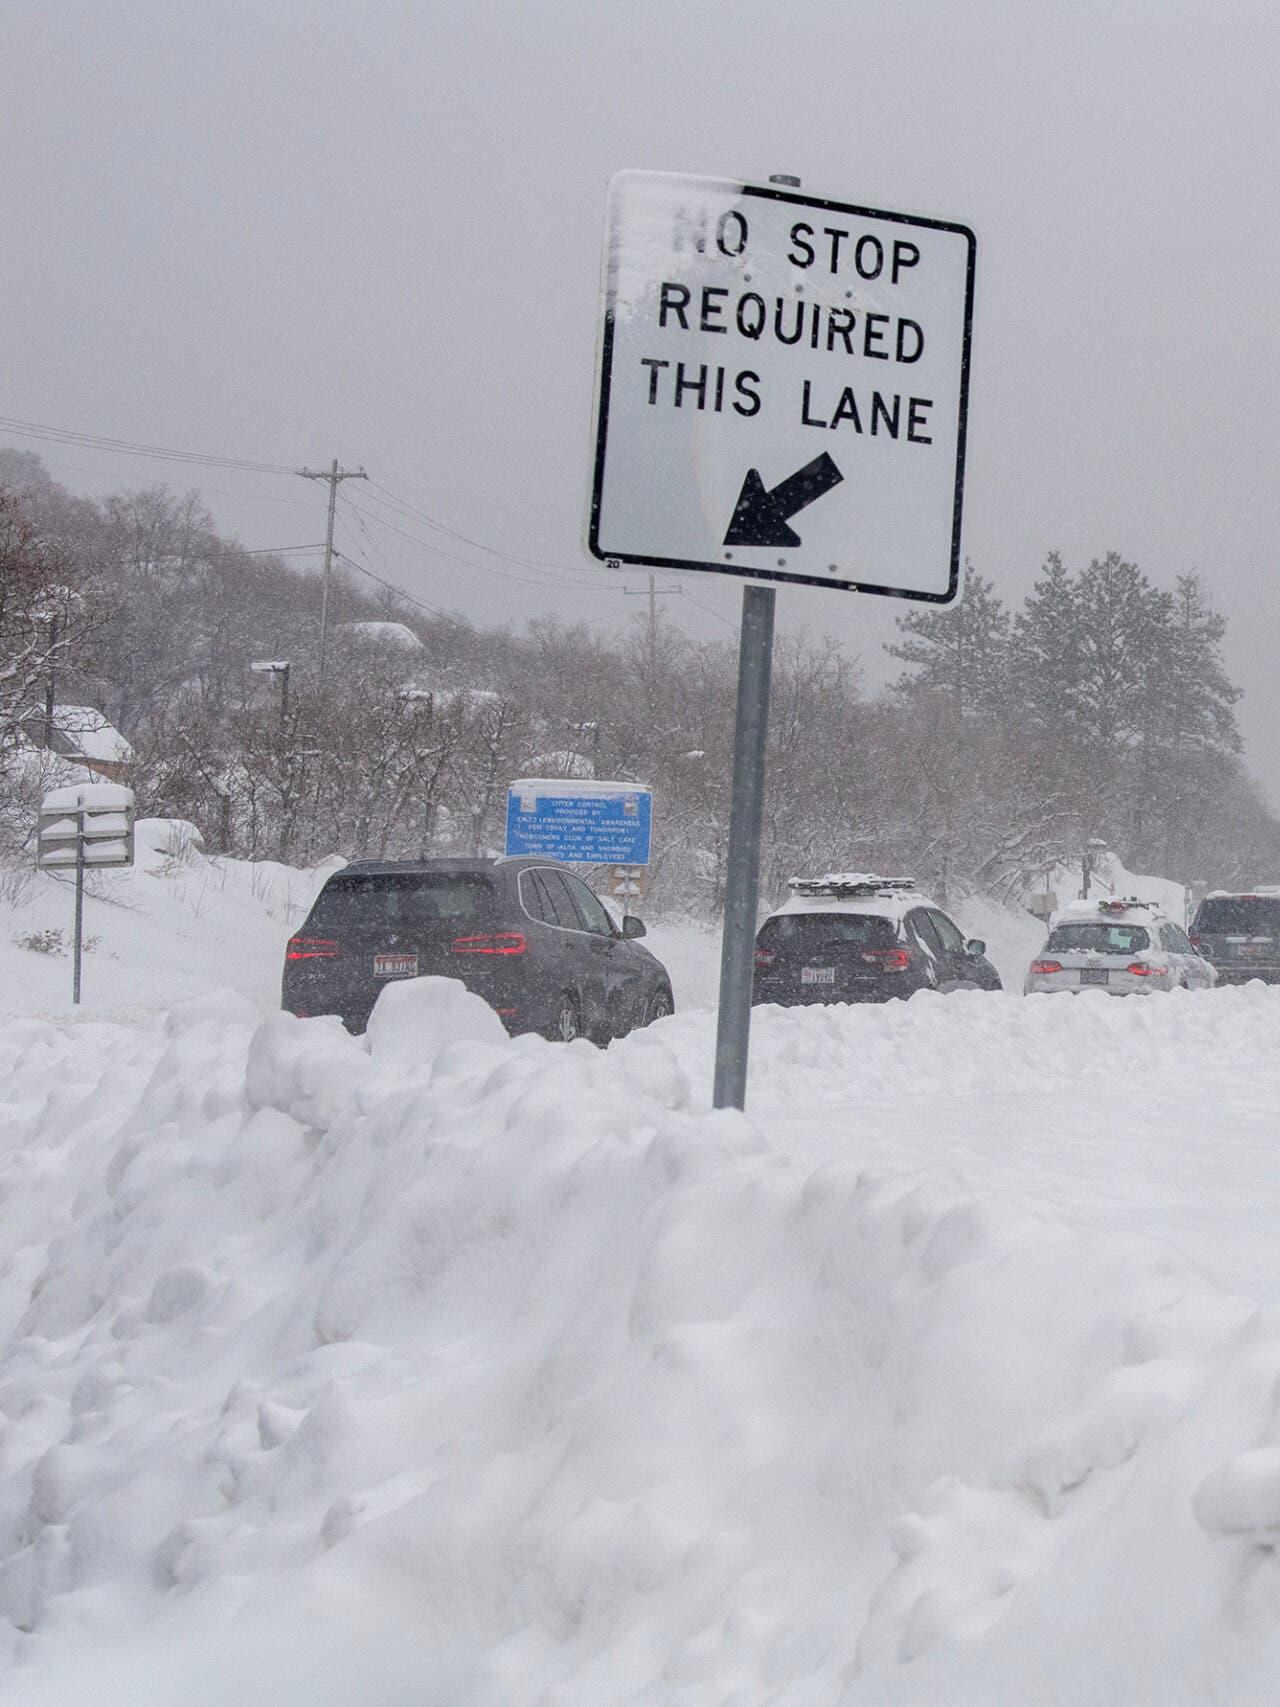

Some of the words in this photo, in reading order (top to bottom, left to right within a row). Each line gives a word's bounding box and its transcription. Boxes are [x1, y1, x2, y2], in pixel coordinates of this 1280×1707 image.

[787, 223, 920, 284] STOP
[659, 282, 923, 364] REQUIRED
[641, 358, 761, 417] THIS
[801, 380, 933, 444] LANE
[607, 559, 620, 568] 20
